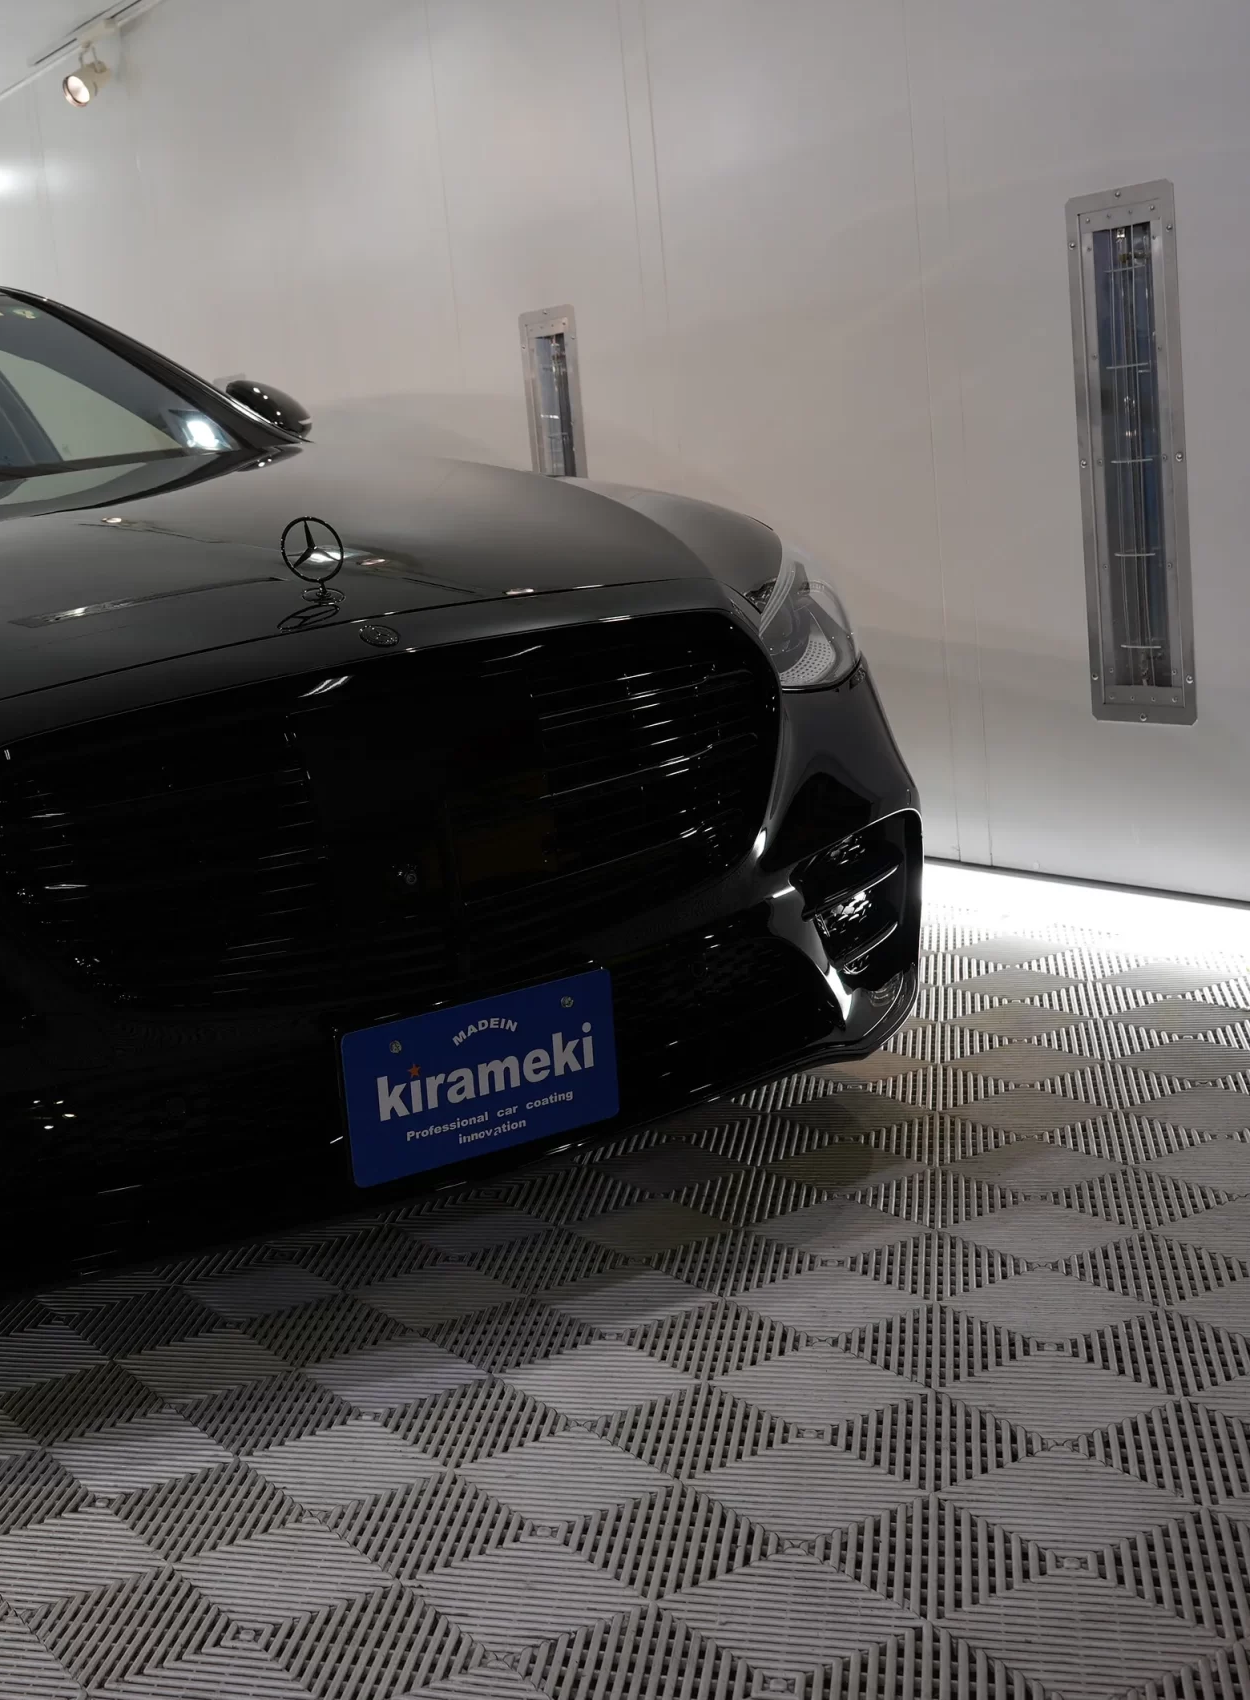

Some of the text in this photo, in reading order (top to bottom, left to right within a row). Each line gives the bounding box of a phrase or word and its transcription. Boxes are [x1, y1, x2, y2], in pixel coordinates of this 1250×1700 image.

[452, 1017, 518, 1046] MADEIN
[376, 1021, 594, 1122] kirameki
[406, 1090, 574, 1141] Professional car coating
[458, 1119, 527, 1144] innovation
